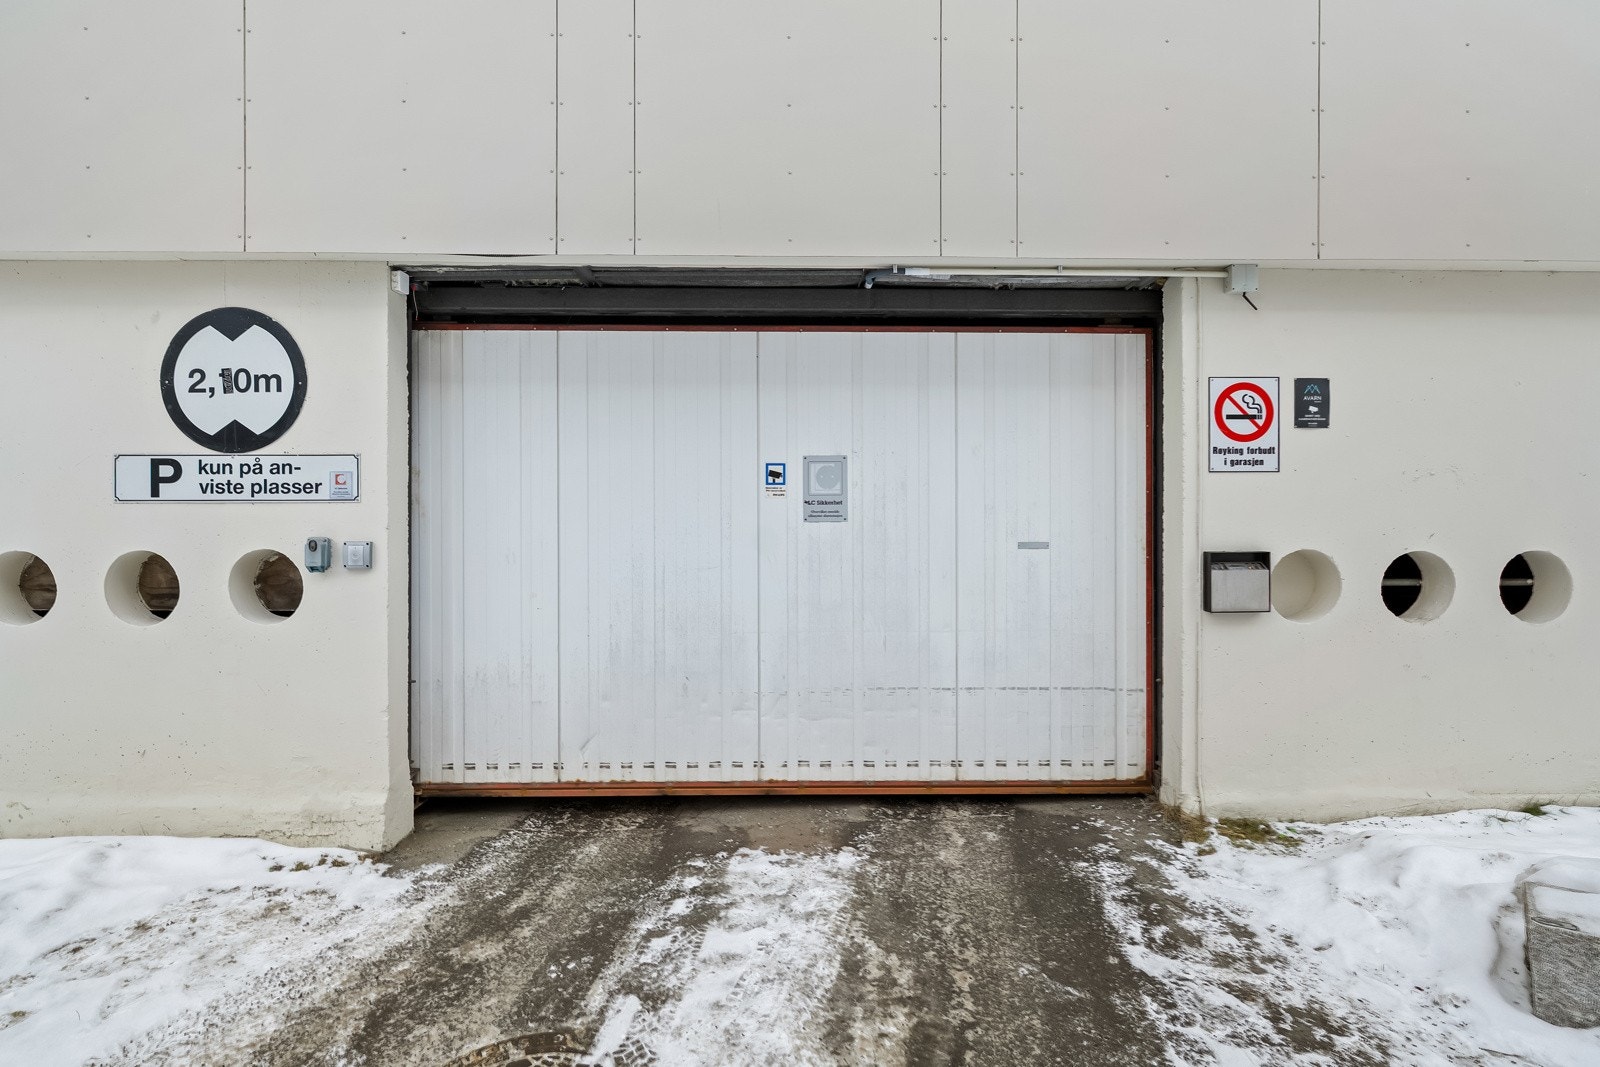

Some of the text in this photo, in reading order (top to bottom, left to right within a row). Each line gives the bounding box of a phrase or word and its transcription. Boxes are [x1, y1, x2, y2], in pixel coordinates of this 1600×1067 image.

[188, 368, 282, 398] 2,0m
[1247, 446, 1275, 455] forbudt
[198, 457, 301, 478] kun på an-
[1223, 457, 1265, 467] i garasjen
[150, 458, 183, 498] P
[199, 479, 322, 498] viste plasser
